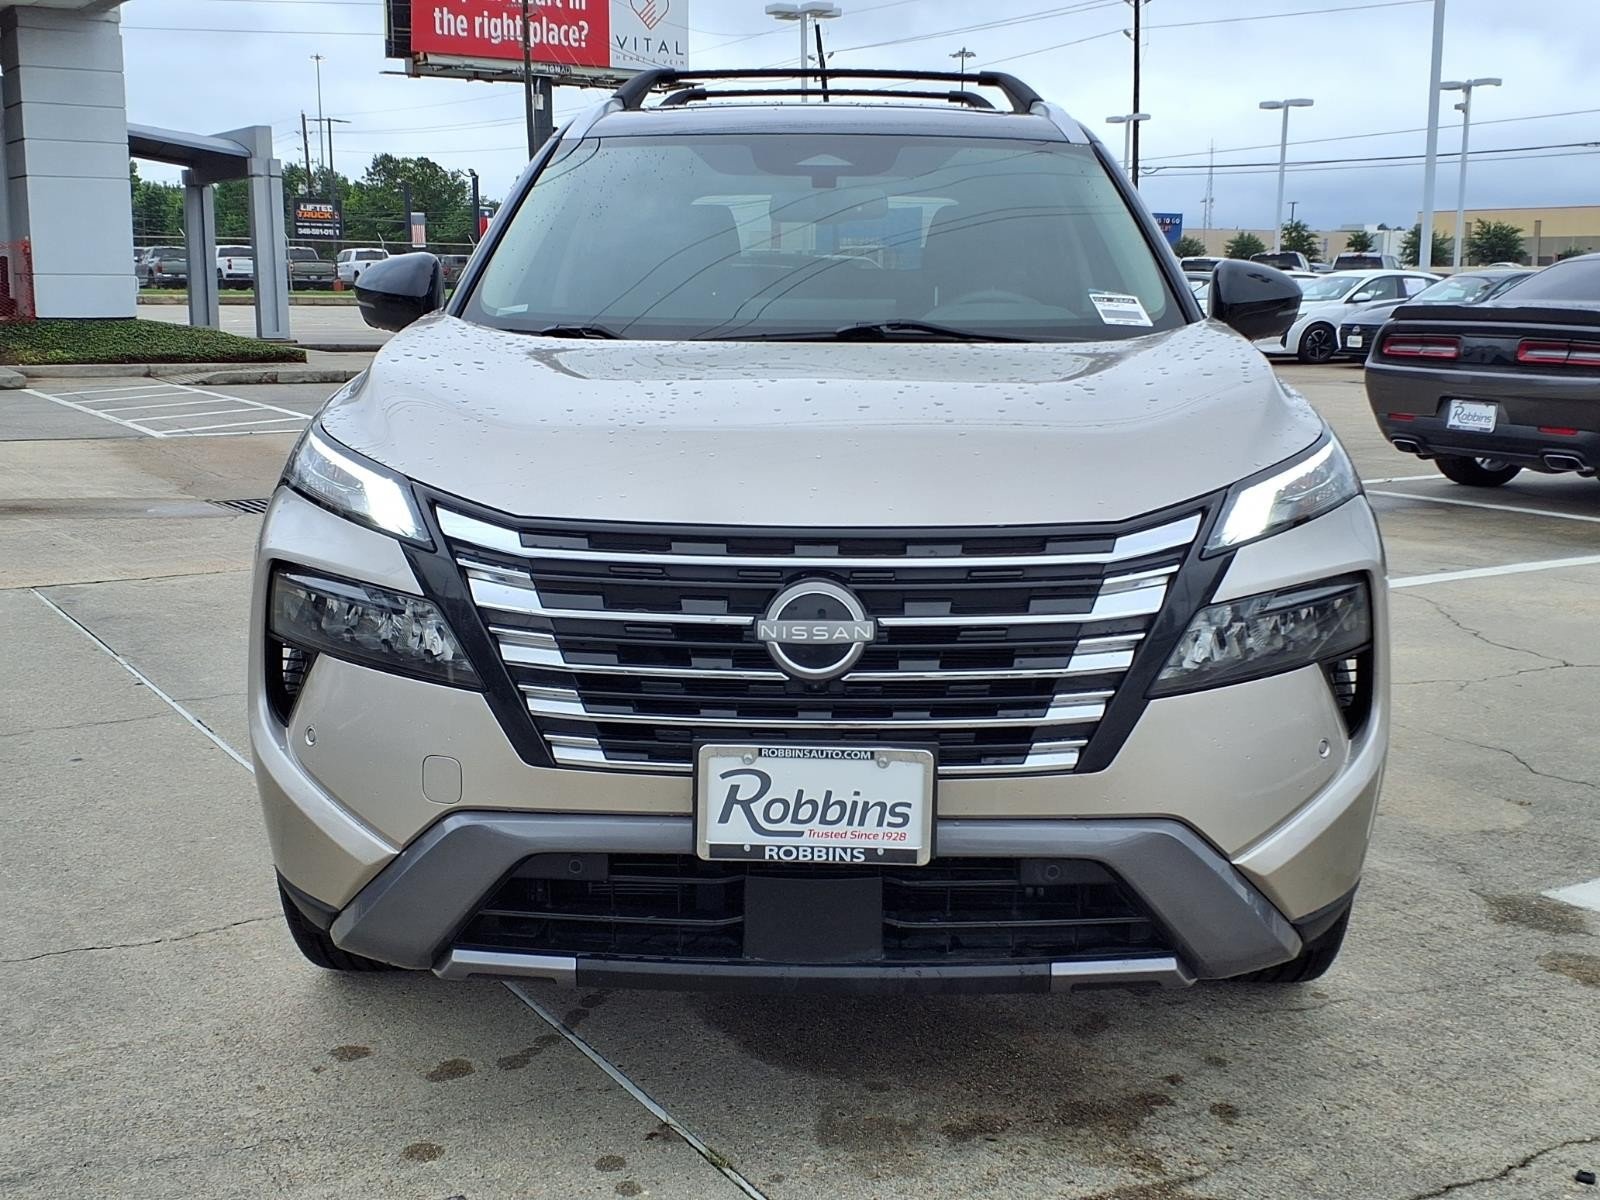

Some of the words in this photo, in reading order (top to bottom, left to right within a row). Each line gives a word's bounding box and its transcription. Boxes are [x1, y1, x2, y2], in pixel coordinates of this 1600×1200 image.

[433, 7, 468, 36] the
[474, 11, 524, 44] right
[529, 16, 589, 48] place?
[615, 34, 684, 55] VITAL
[300, 203, 334, 212] LIFTED
[1452, 405, 1492, 424] Robbins
[760, 625, 871, 640] NISSAN
[761, 749, 872, 760] ROBBINSAUTO.COM
[717, 768, 913, 838] Robbins
[808, 829, 847, 839] Trusted
[849, 830, 880, 840] Since
[881, 832, 907, 841] 1928
[764, 845, 866, 862] ROBBINS
